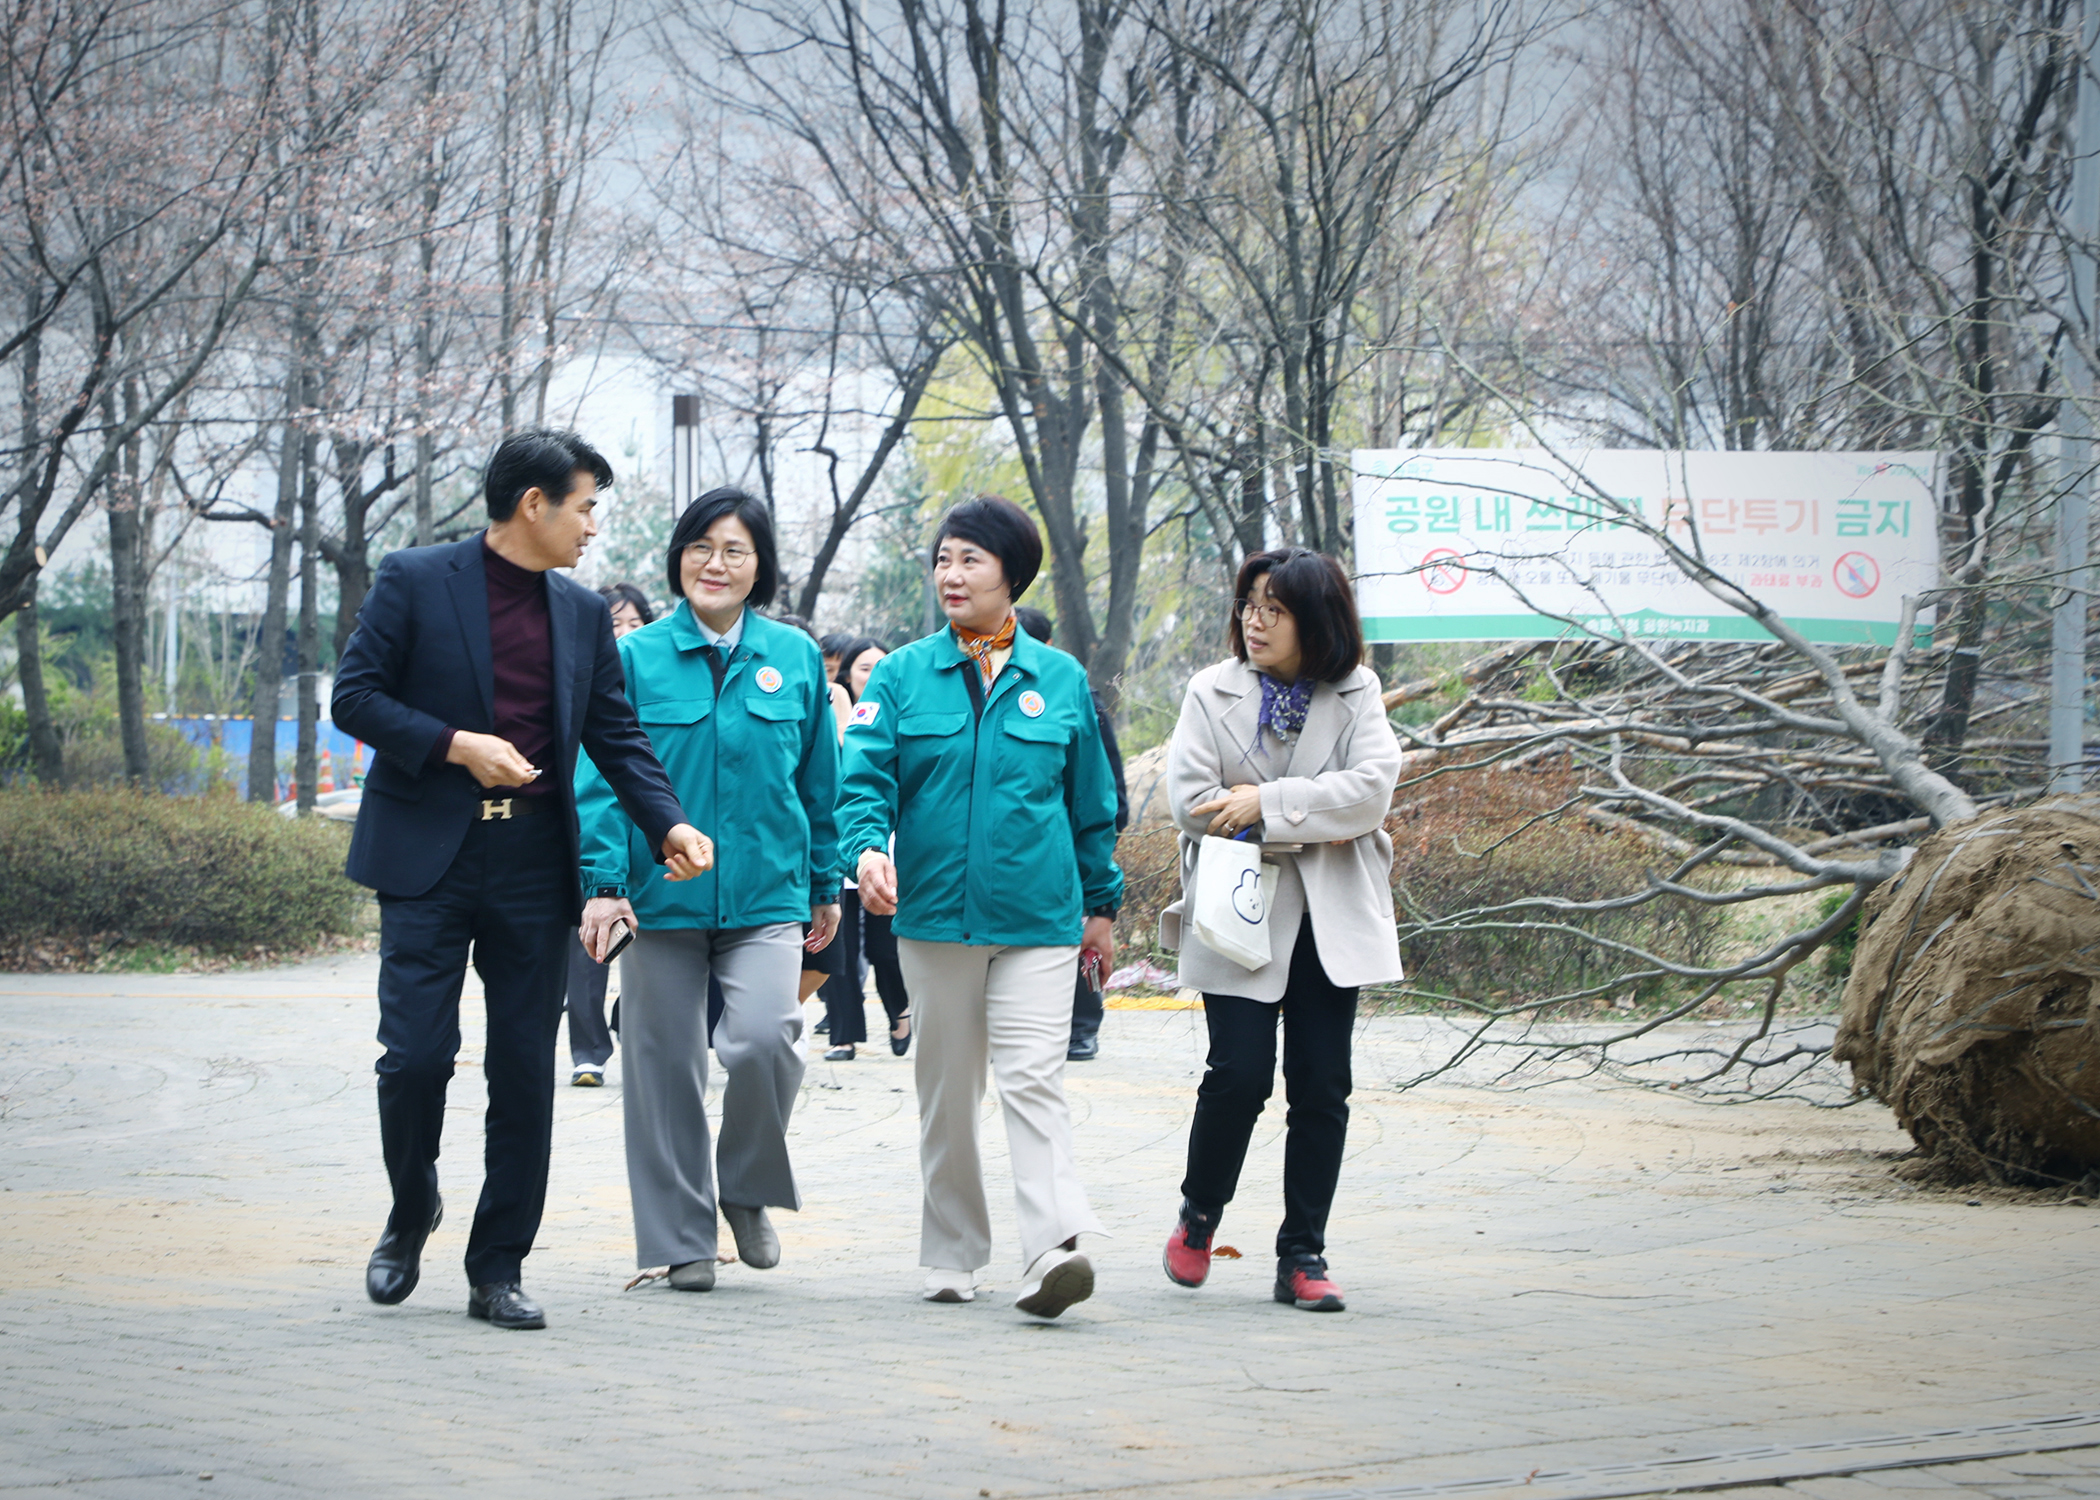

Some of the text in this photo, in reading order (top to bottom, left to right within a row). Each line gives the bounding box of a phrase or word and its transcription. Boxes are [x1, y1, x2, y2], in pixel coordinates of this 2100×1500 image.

[1385, 495, 1460, 533] 공원
[1475, 496, 1511, 532] 내
[1659, 497, 1819, 536] 무단투기
[1835, 498, 1911, 538] 금지
[481, 797, 513, 821] H
